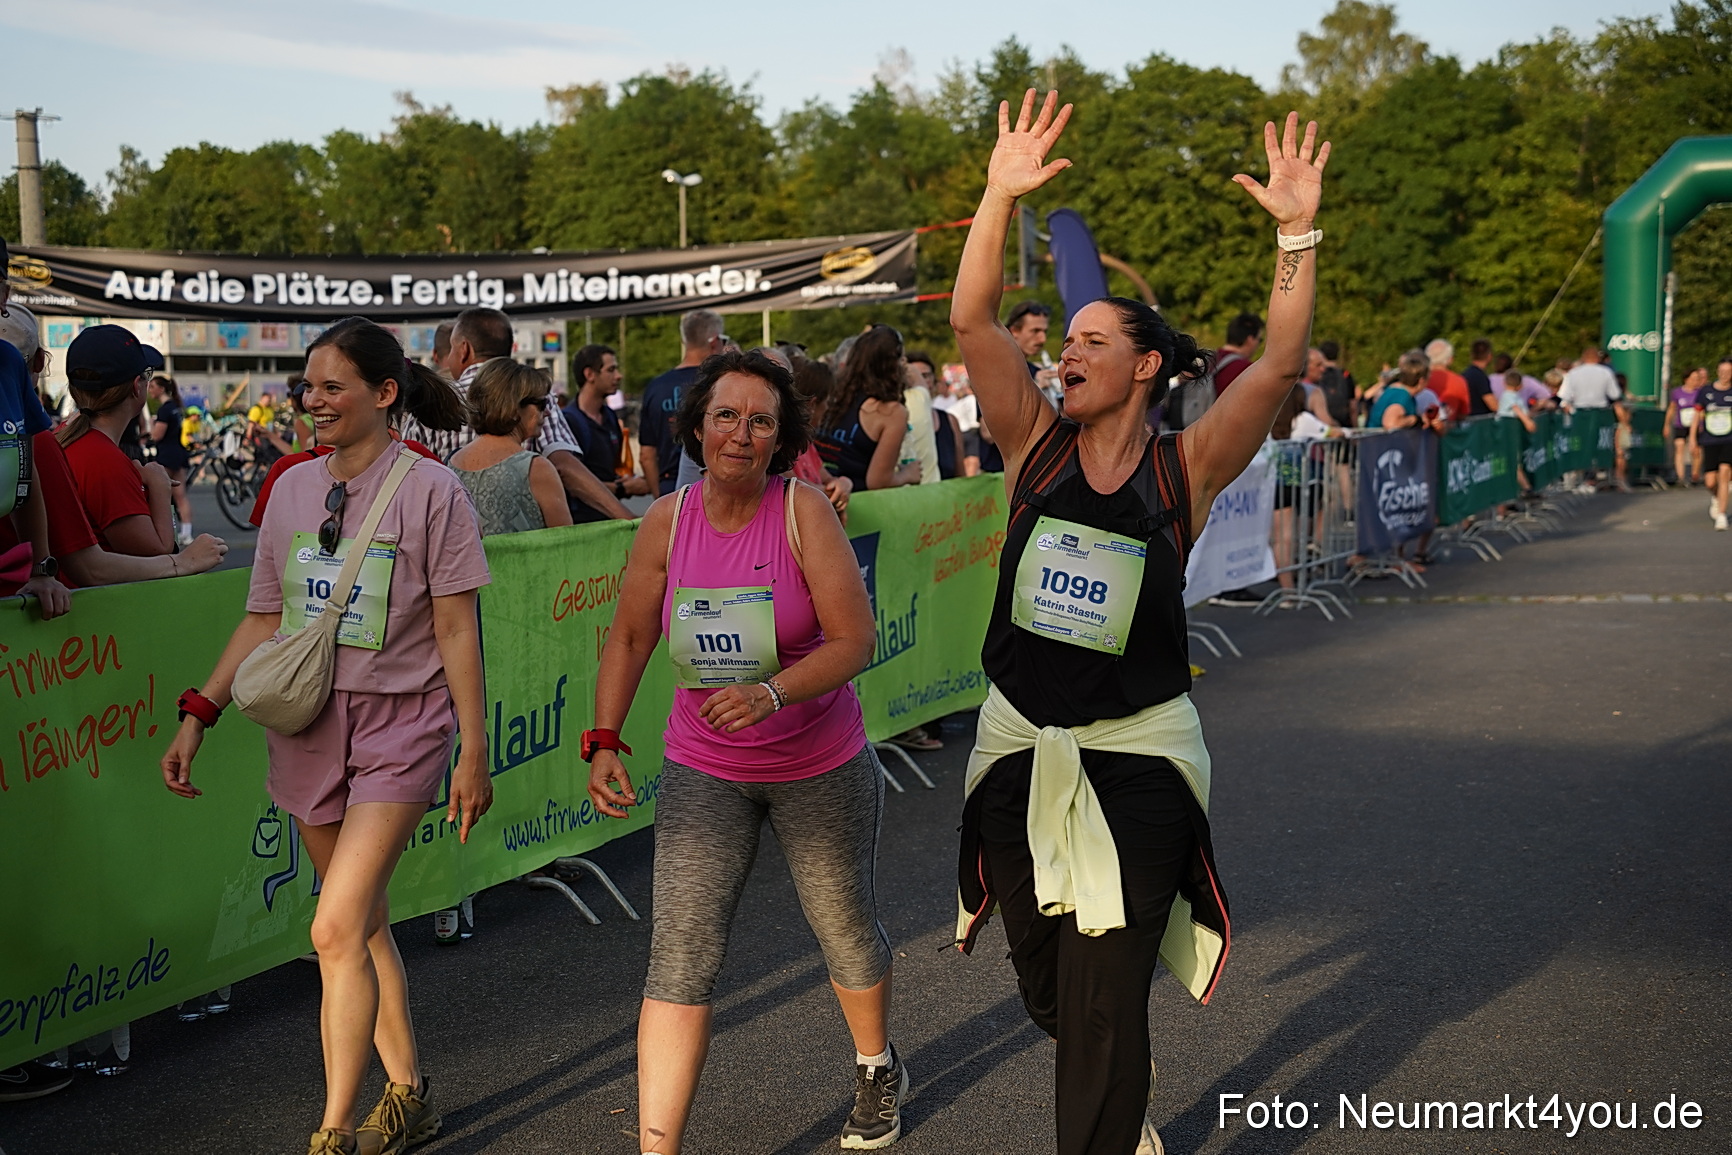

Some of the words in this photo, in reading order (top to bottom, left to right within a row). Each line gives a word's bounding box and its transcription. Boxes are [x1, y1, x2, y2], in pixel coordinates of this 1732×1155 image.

[104, 269, 175, 301] Auf
[182, 271, 246, 304] die
[253, 272, 385, 307] Plätze.
[392, 270, 516, 310] Fertig.
[523, 264, 772, 303] Miteinander.
[1607, 333, 1644, 350] AOK
[969, 530, 1006, 568] länge
[1053, 544, 1091, 556] Firmenlauf
[306, 578, 363, 604] 107
[1040, 566, 1108, 605] 1098
[690, 608, 722, 617] Firmenlauf
[1033, 595, 1065, 612] Katrin
[1066, 604, 1108, 624] Stastny
[695, 633, 742, 653] 1101
[690, 657, 717, 667] Sonja
[718, 657, 760, 666] Witmann
[18, 673, 158, 784] länger!
